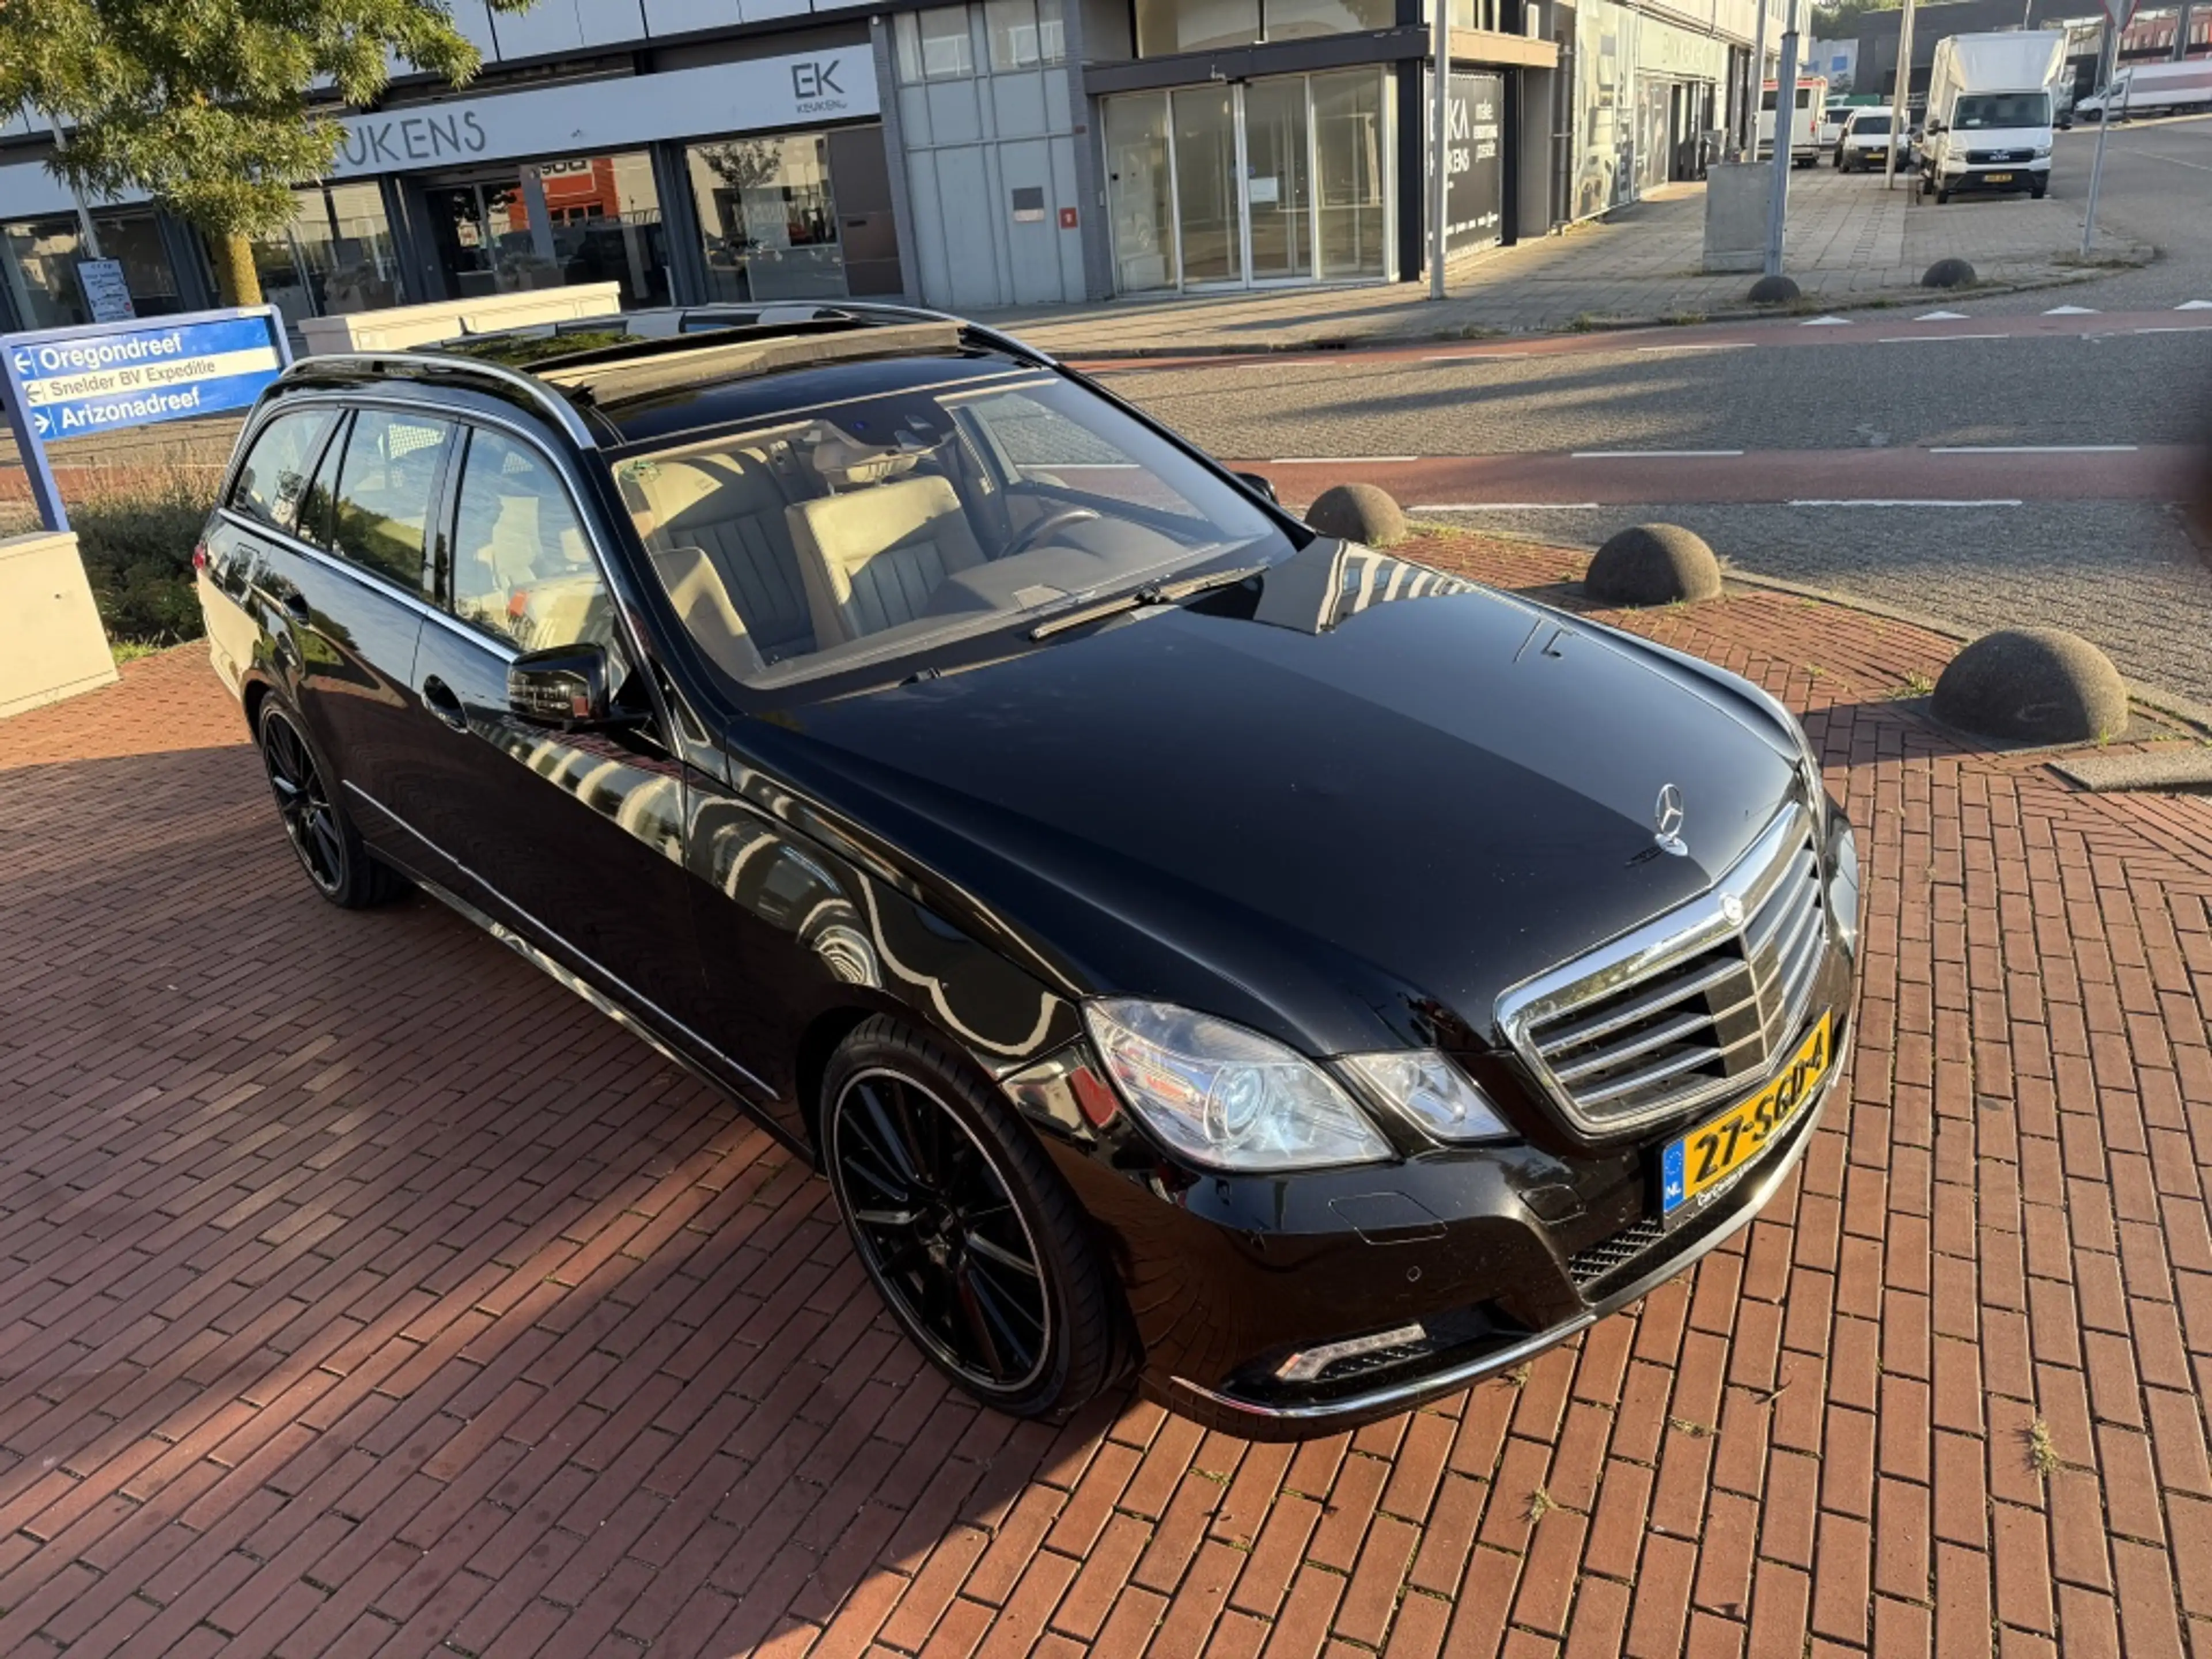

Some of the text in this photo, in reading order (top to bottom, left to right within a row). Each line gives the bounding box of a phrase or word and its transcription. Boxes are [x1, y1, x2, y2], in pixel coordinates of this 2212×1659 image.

[791, 59, 845, 99] EK
[333, 111, 485, 169] UKENS
[39, 332, 182, 370] Oregondreef
[50, 359, 215, 397] Snelder BV Expeditie
[62, 386, 200, 429] Arizonadreef
[1666, 1181, 1682, 1199] NL
